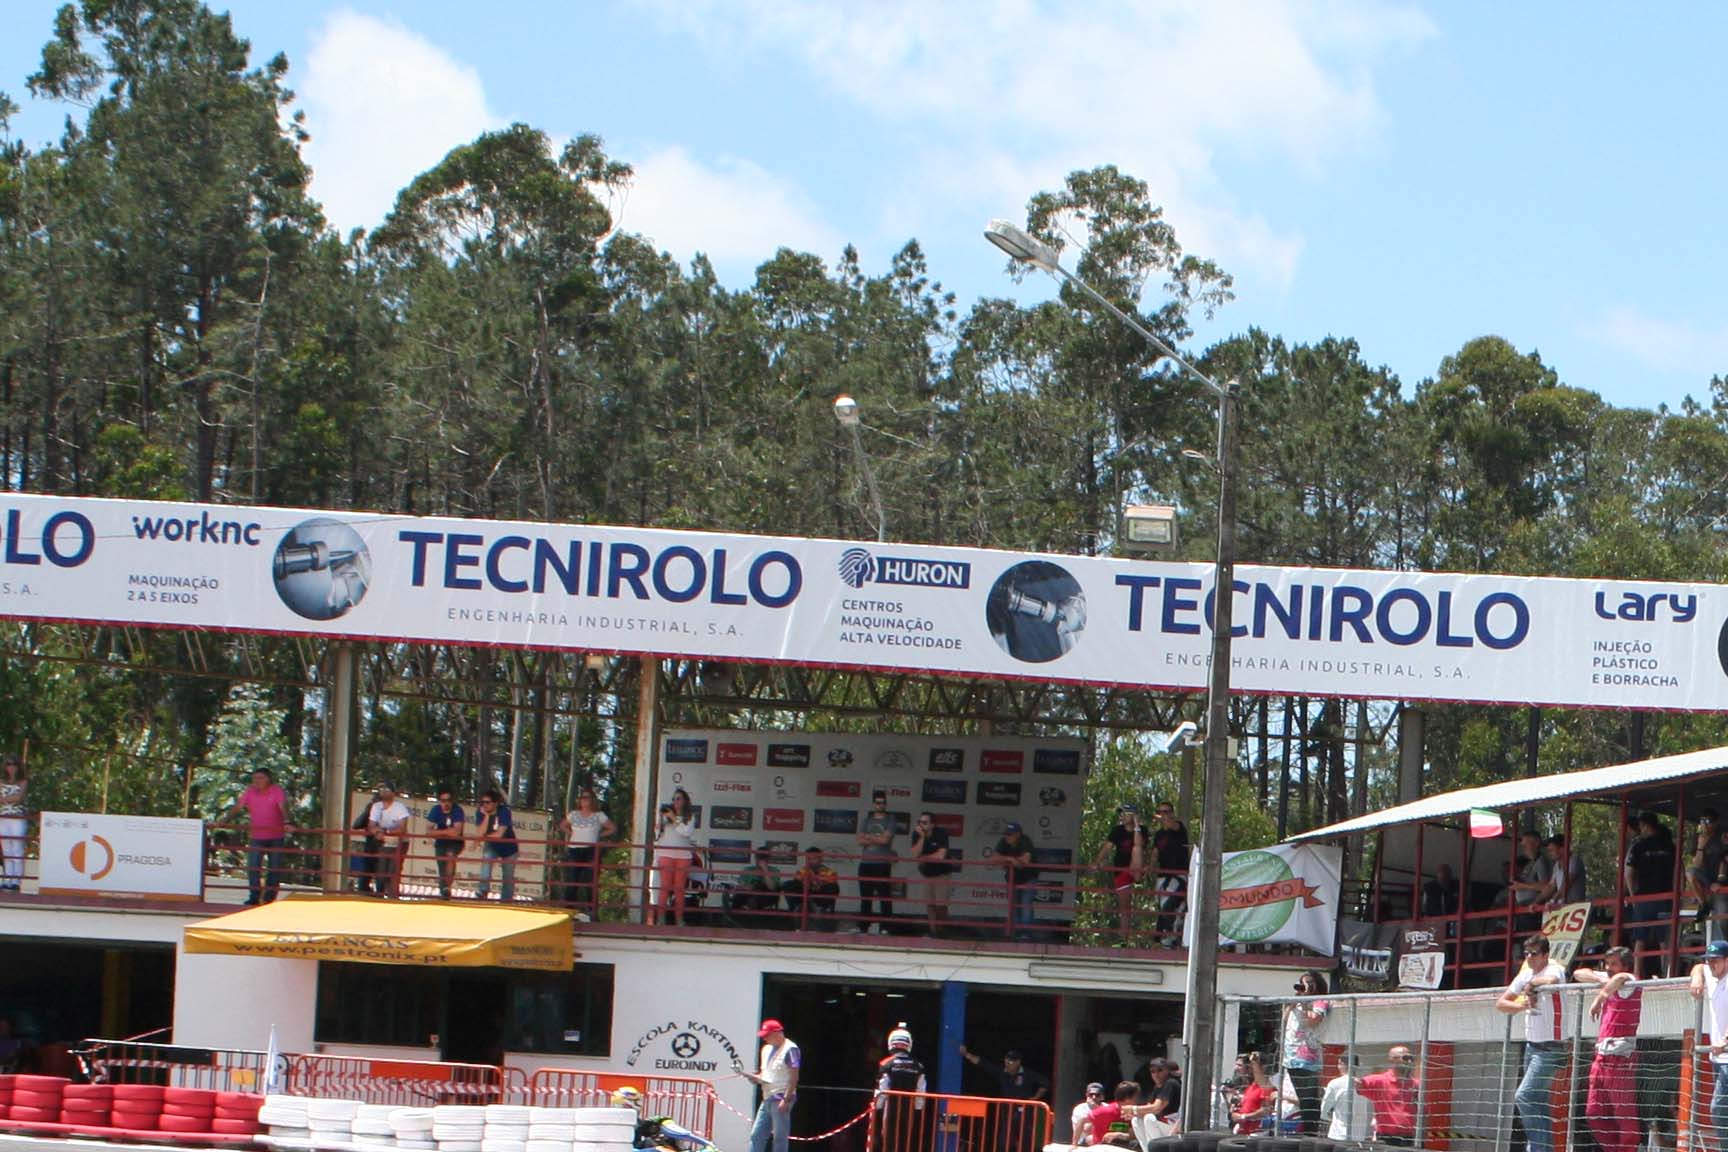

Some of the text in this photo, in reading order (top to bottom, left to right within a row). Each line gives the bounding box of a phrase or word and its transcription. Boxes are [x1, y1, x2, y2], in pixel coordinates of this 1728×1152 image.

[132, 511, 262, 546] worknc
[0, 509, 95, 568] LO
[399, 530, 803, 609] TECNIROLO
[884, 562, 963, 586] HURON
[128, 574, 219, 590] MAQUINAÇÃO
[127, 591, 135, 601] 2
[138, 591, 148, 602] A
[160, 592, 199, 605] EIXOS
[842, 599, 904, 613] CENTROS
[1115, 573, 1531, 650] TECNIROLO
[447, 608, 744, 638] ENGENHARIA INDUSTRIAL, S.A.
[840, 615, 934, 632] MAQUINAÇÃO
[840, 632, 963, 650] ALTA VELOCIDADE
[1593, 640, 1652, 656] INJEÇÃO
[1165, 652, 1472, 680] ENGEHARIA INDUSTRIAL, S.A.
[1592, 655, 1659, 670] PLÁSTICO
[1592, 673, 1679, 688] E BORRACHA
[118, 854, 172, 867] PRAGOSA
[233, 943, 450, 964] www.pestronix.pt
[626, 1021, 678, 1067] ESCOLA
[655, 1058, 718, 1072] EUROINDY
